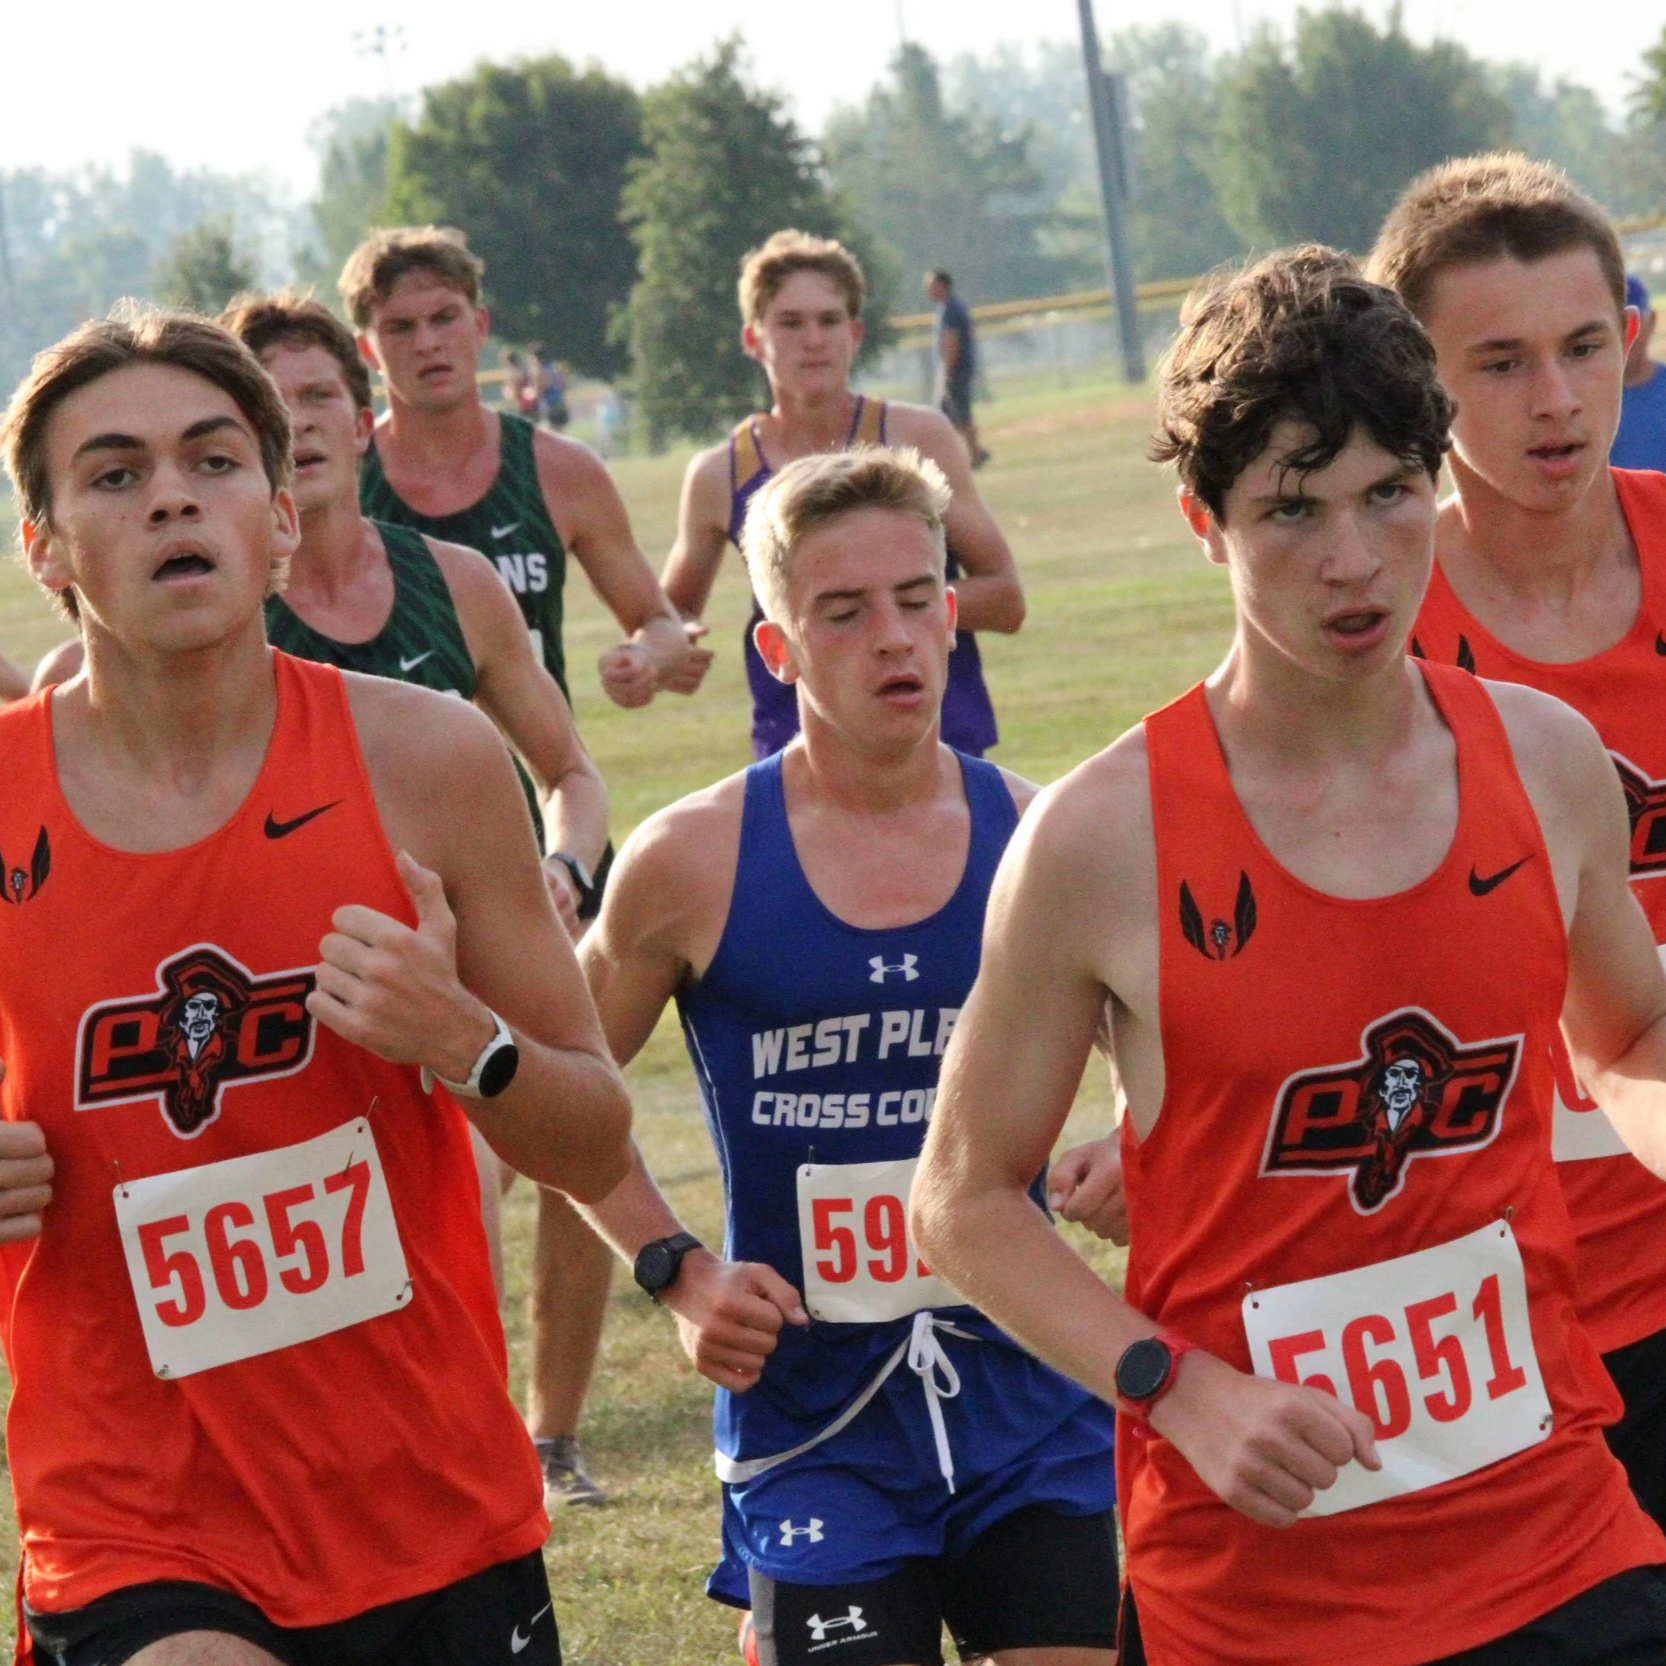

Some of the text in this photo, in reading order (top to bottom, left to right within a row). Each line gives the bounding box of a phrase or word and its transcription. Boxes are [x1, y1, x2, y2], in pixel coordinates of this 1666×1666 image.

[752, 1014, 870, 1079] WEST
[752, 1091, 870, 1128] CROSS
[137, 1160, 372, 1328] 5657
[811, 1194, 933, 1284] 59
